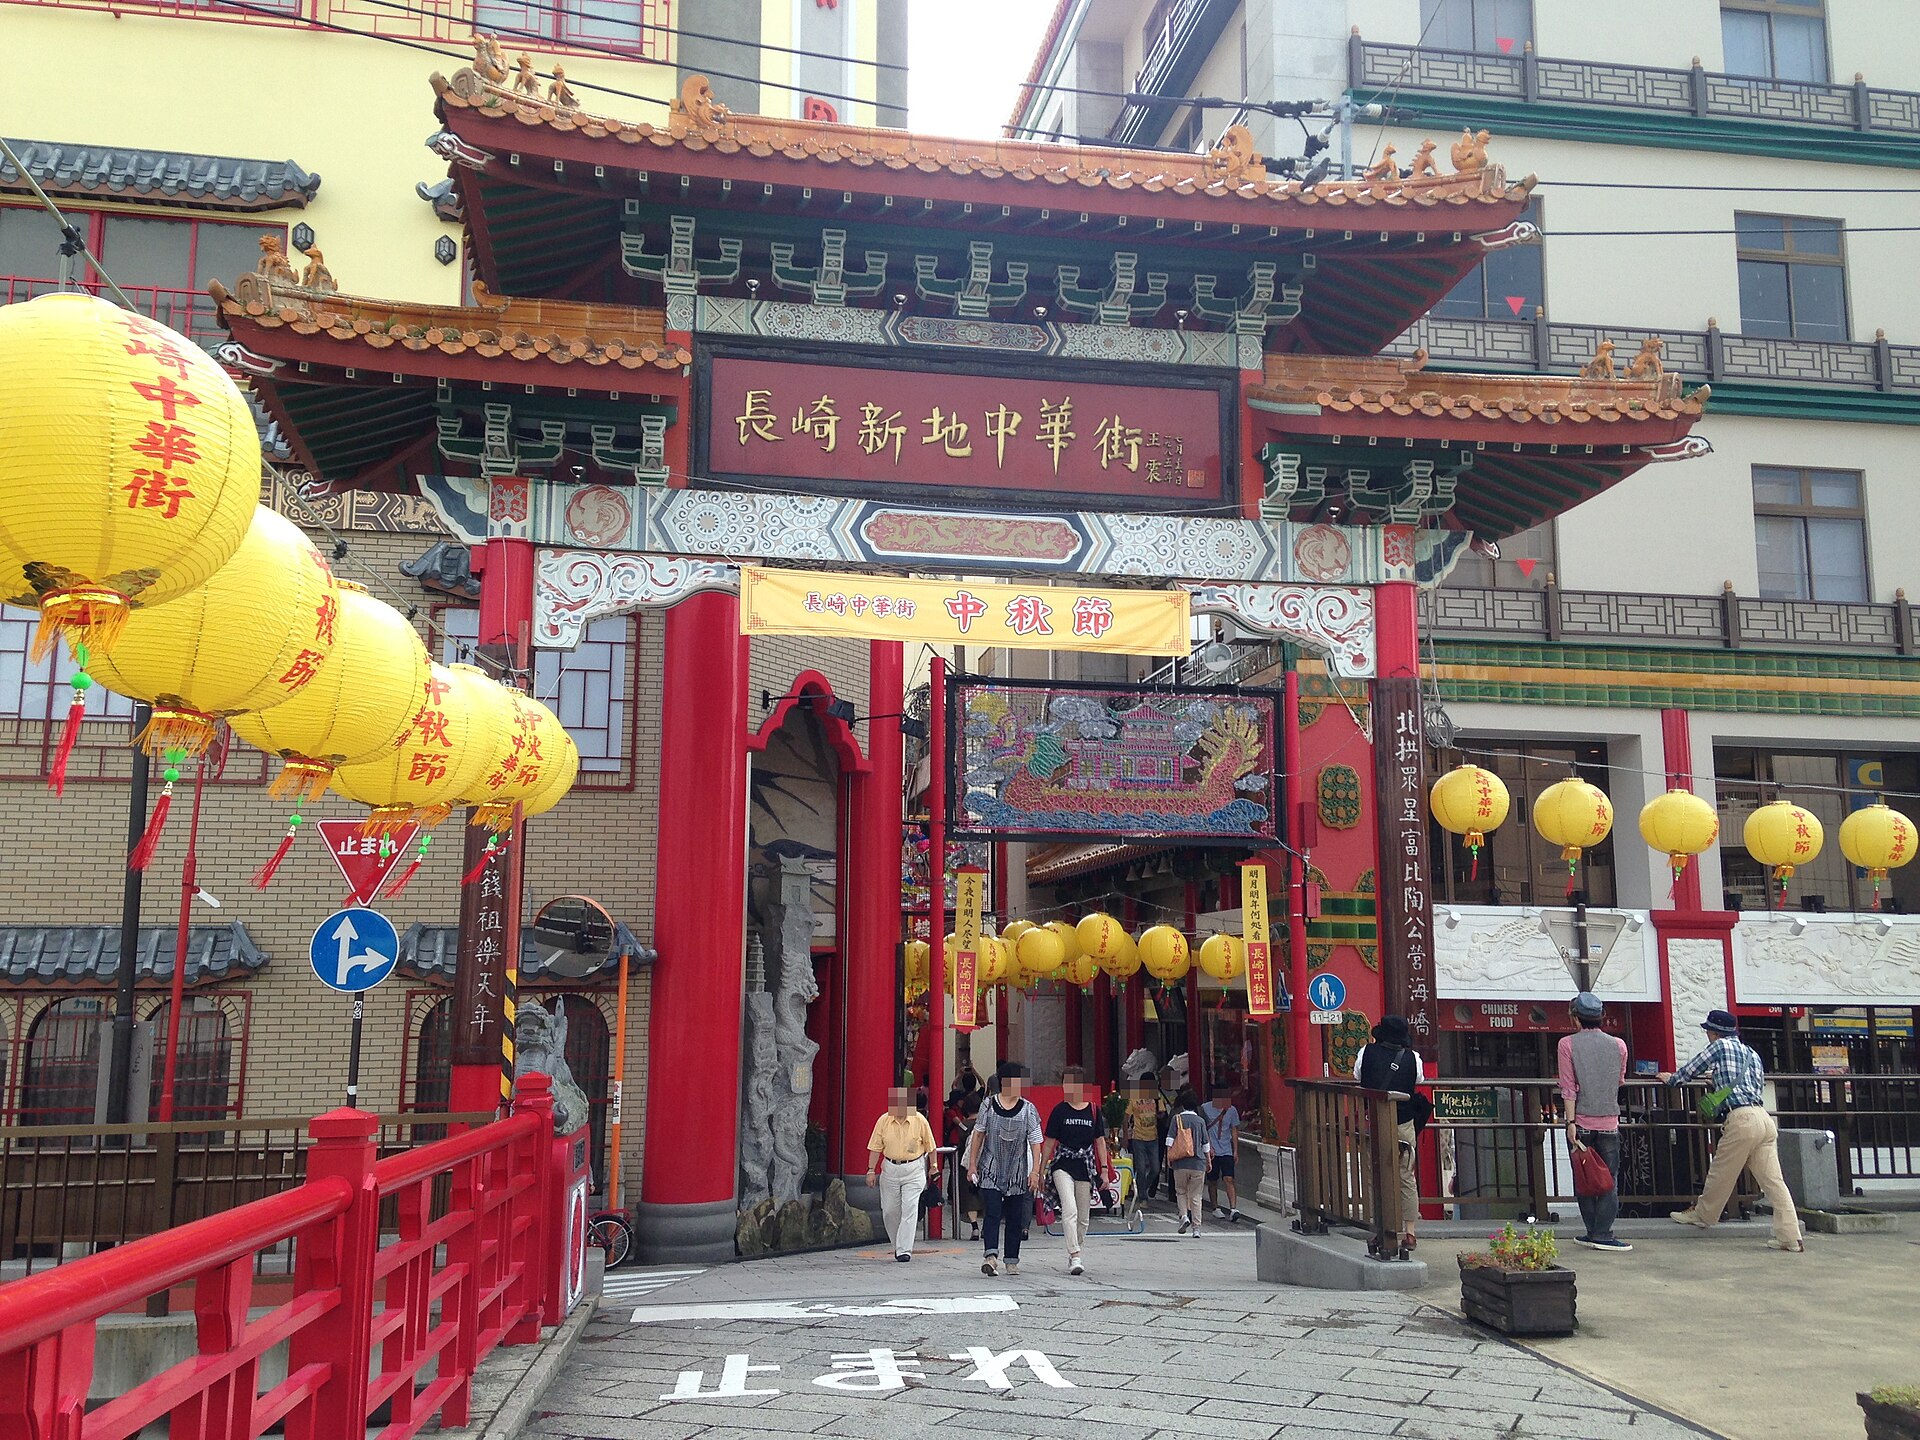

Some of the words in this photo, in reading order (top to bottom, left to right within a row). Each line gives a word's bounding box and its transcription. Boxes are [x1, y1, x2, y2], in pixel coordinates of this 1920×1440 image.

[734, 389, 1143, 475] 長崎新地中華街
[1145, 432, 1162, 483] 王震
[804, 591, 915, 620] 長崎中華街
[947, 590, 1113, 638] 中秋節
[407, 677, 453, 787] 中秋節
[1474, 771, 1493, 818] 長崎中華街
[1592, 790, 1608, 837] 中秋節
[1791, 810, 1812, 855] 中秋節
[1887, 816, 1908, 862] 長崎中華街
[1171, 933, 1183, 965] 中秋節
[959, 957, 973, 1015] 長崎中秋節
[1252, 948, 1266, 1006] 長崎中秋節
[1481, 1003, 1519, 1015] CHINESE
[1489, 1016, 1514, 1028] FOOD
[658, 1346, 1078, 1401] 止まれ
